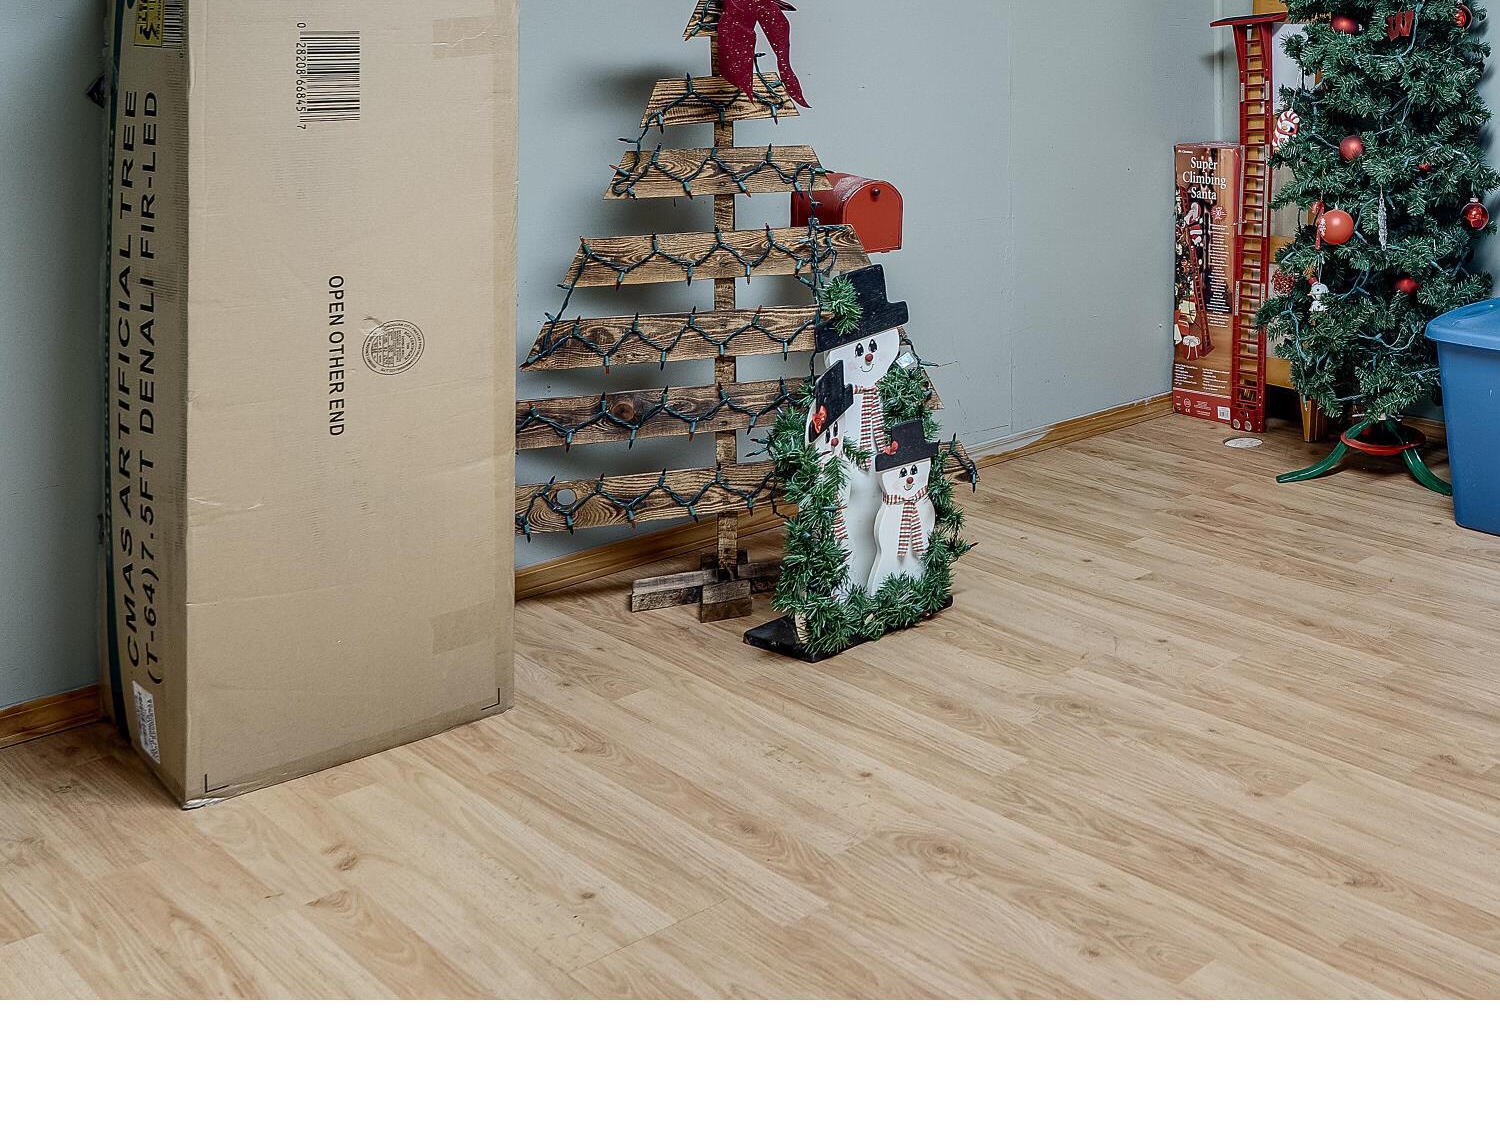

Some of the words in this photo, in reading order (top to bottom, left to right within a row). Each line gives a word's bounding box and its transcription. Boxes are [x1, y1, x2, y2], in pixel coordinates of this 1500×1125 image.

[296, 42, 307, 75] 28208
[296, 79, 307, 112] 66845
[118, 91, 138, 217] TREE
[140, 91, 158, 259] FIR-LED
[1182, 170, 1227, 189] Climbing
[1190, 156, 1218, 173] Super
[1190, 186, 1217, 200] Santa
[328, 275, 345, 326] OPEN
[117, 230, 133, 518] ARTIFICIAL
[137, 276, 156, 434] DENALI
[328, 331, 345, 395] OTHER
[329, 398, 345, 436] END
[120, 527, 140, 668] CMAS
